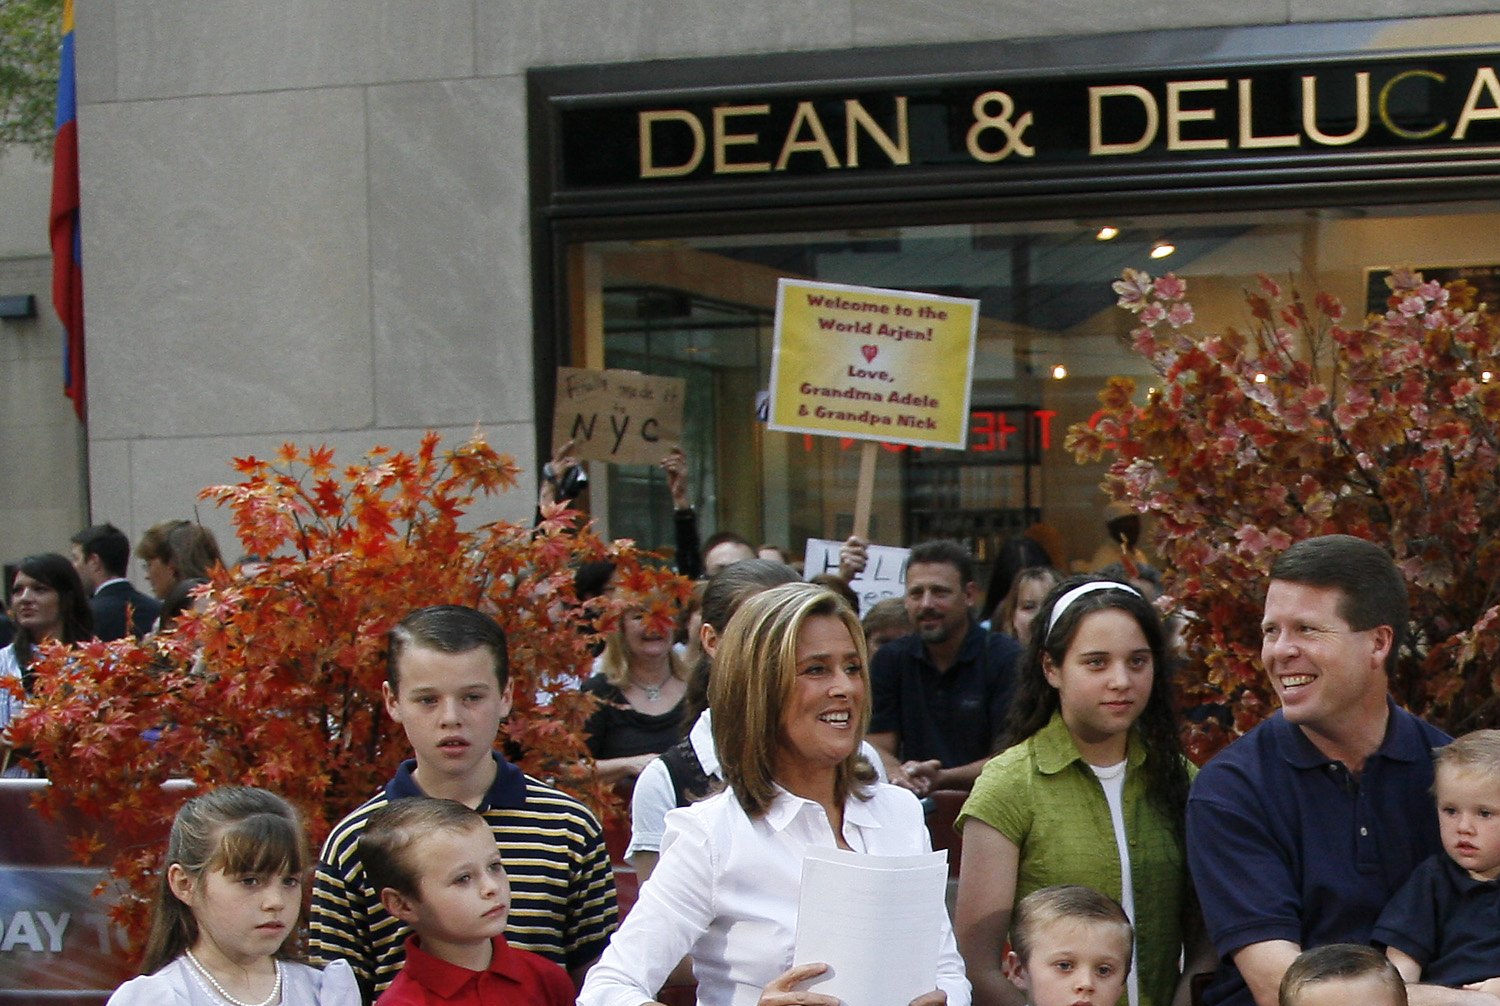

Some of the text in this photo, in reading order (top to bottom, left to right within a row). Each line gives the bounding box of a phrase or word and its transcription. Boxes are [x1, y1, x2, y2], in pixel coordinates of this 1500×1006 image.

[638, 96, 912, 179] DEAN
[965, 91, 1036, 163] &
[807, 294, 948, 321] Welcome to the
[818, 318, 933, 341] World Arjen!
[848, 365, 894, 383] Love,
[800, 382, 939, 408] Grandma Adele
[799, 404, 937, 430] & Grandpa Nick
[0, 910, 71, 952] AY
